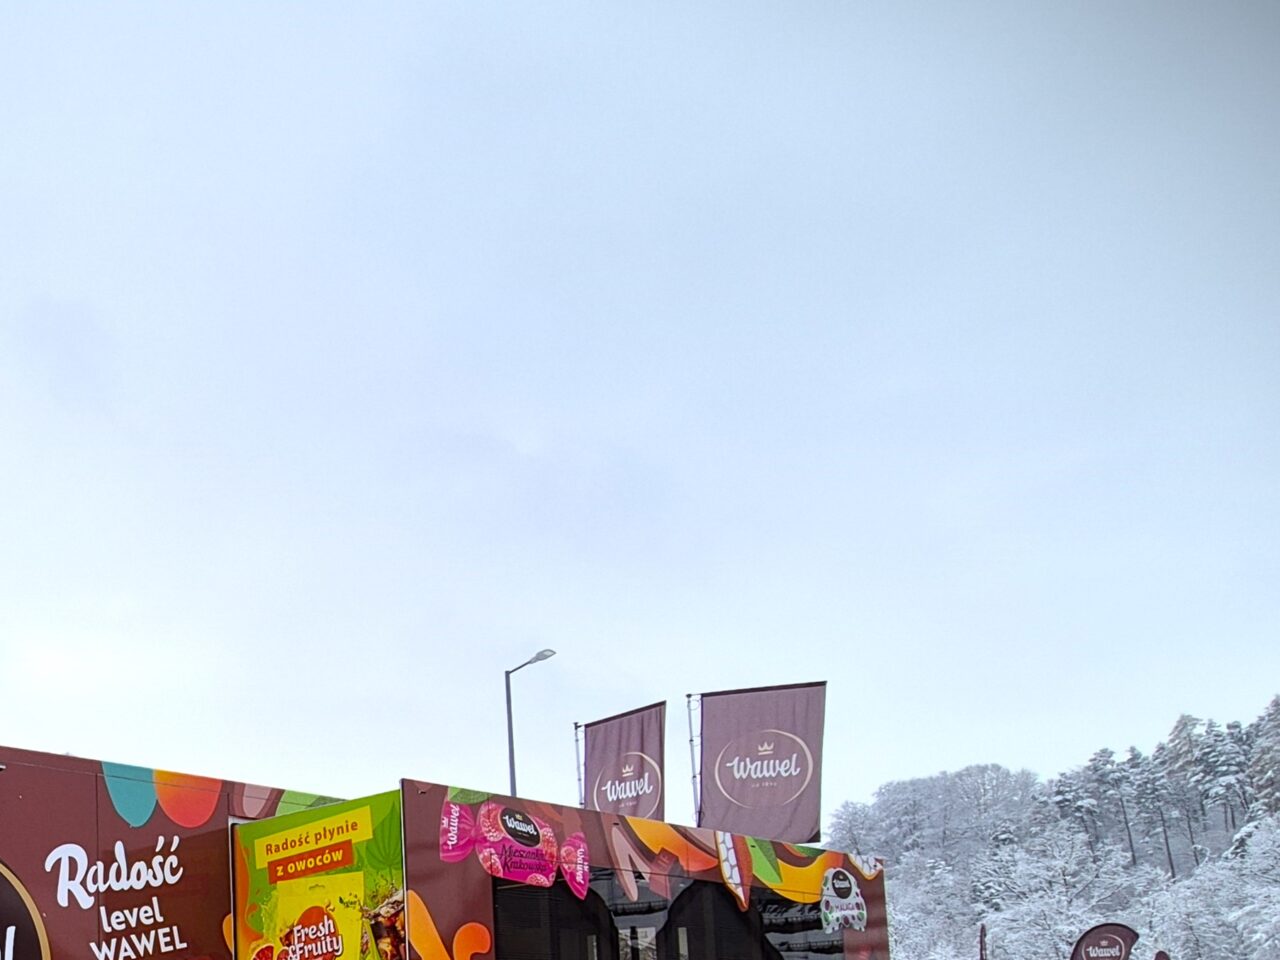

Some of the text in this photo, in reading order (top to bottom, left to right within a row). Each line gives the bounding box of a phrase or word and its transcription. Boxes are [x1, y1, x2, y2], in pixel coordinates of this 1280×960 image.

[726, 753, 801, 780] Wawel
[601, 771, 654, 803] Wawel
[265, 820, 358, 856] Radość płynie
[502, 814, 537, 836] Wawel
[45, 835, 184, 910] Radość
[276, 849, 343, 877] z owoców
[99, 896, 164, 933] level
[293, 914, 335, 945] Fresh
